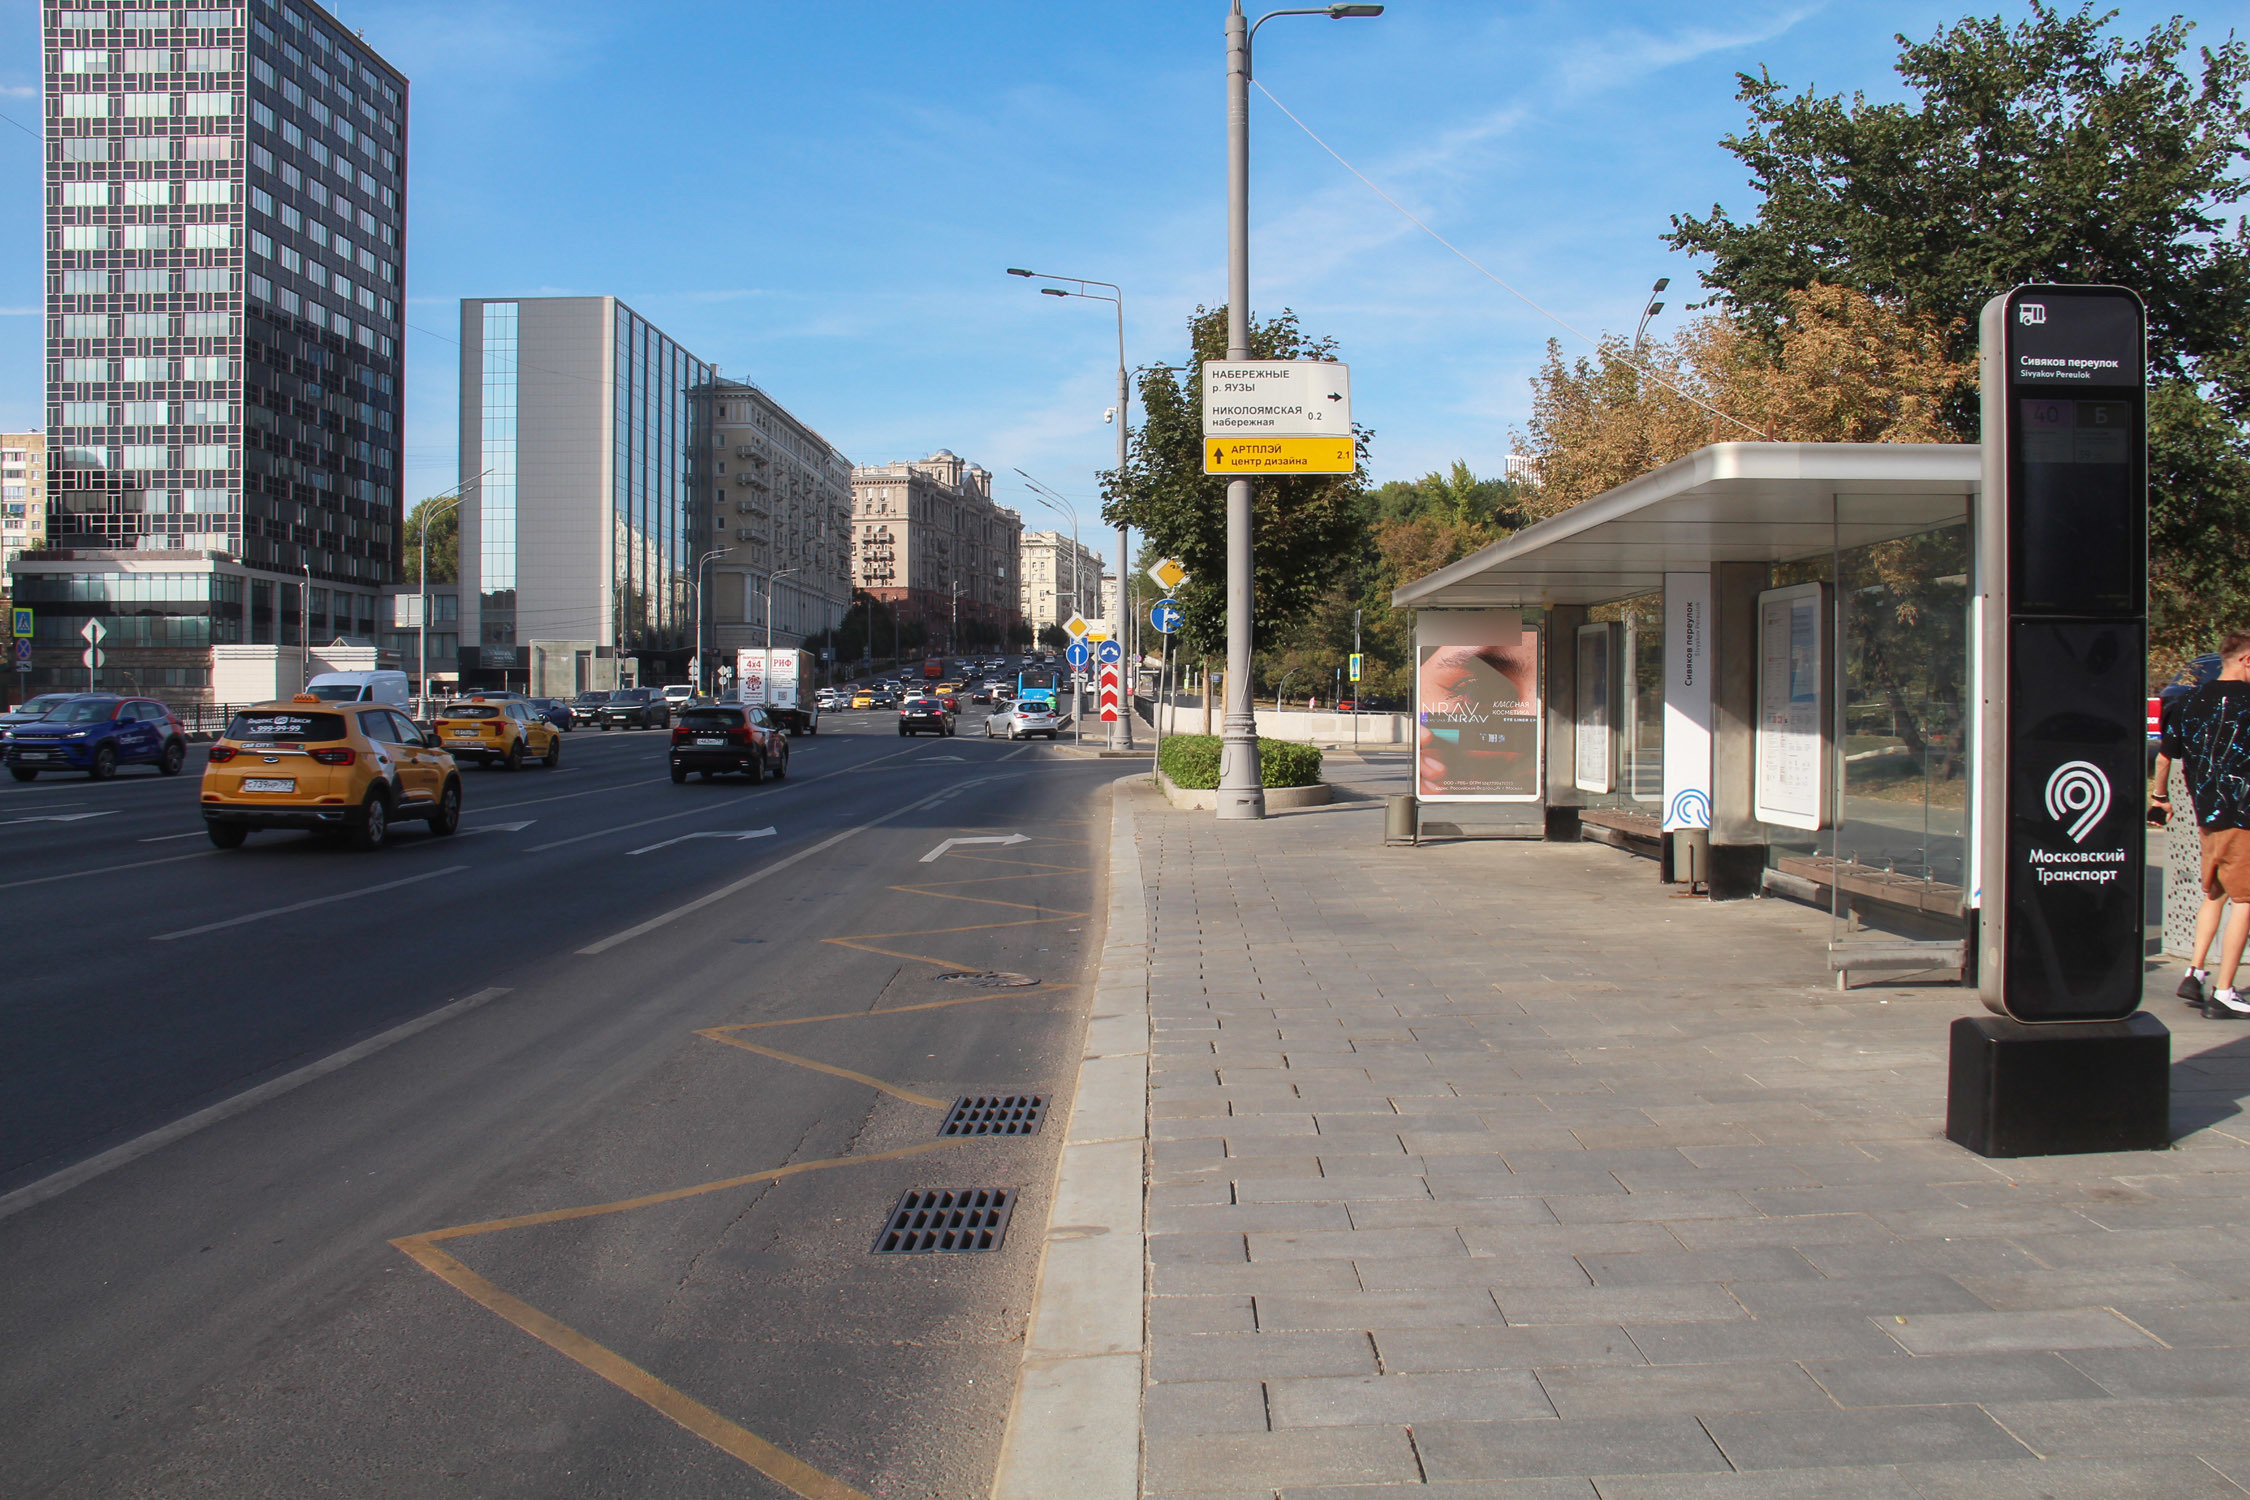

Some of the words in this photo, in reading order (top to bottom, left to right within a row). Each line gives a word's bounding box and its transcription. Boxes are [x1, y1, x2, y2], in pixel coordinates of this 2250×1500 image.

[2020, 355, 2066, 367] Сивяков
[2067, 359, 2119, 369] переулок
[1212, 370, 1290, 379] НАБЕРЕЖНЫЕ
[2020, 369, 2055, 378] Sivyakov
[2055, 370, 2091, 378] Pereulok
[1212, 386, 1221, 394] р.
[1224, 383, 1255, 392] ЯУЗЫ
[1212, 406, 1302, 415] НИКОЛОЯМСКАЯ
[2034, 405, 2058, 423] 40
[1307, 412, 1322, 421] 0.2
[1212, 418, 1275, 428] набережная
[1231, 444, 1282, 454] АРТПЛЭЙ
[1336, 451, 1350, 460] 2.1
[1231, 458, 1262, 467] центр
[1264, 457, 1308, 466] дизайна
[1686, 601, 1695, 646] переулок
[773, 659, 792, 667] РИФ
[1684, 648, 1693, 687] Сивяков
[1422, 701, 1480, 716] NRAV
[1492, 700, 1530, 709] КЛАССНАЯ
[1447, 713, 1489, 724] NRAV
[2028, 848, 2126, 864] Московский
[2036, 867, 2118, 886] Транспорт
